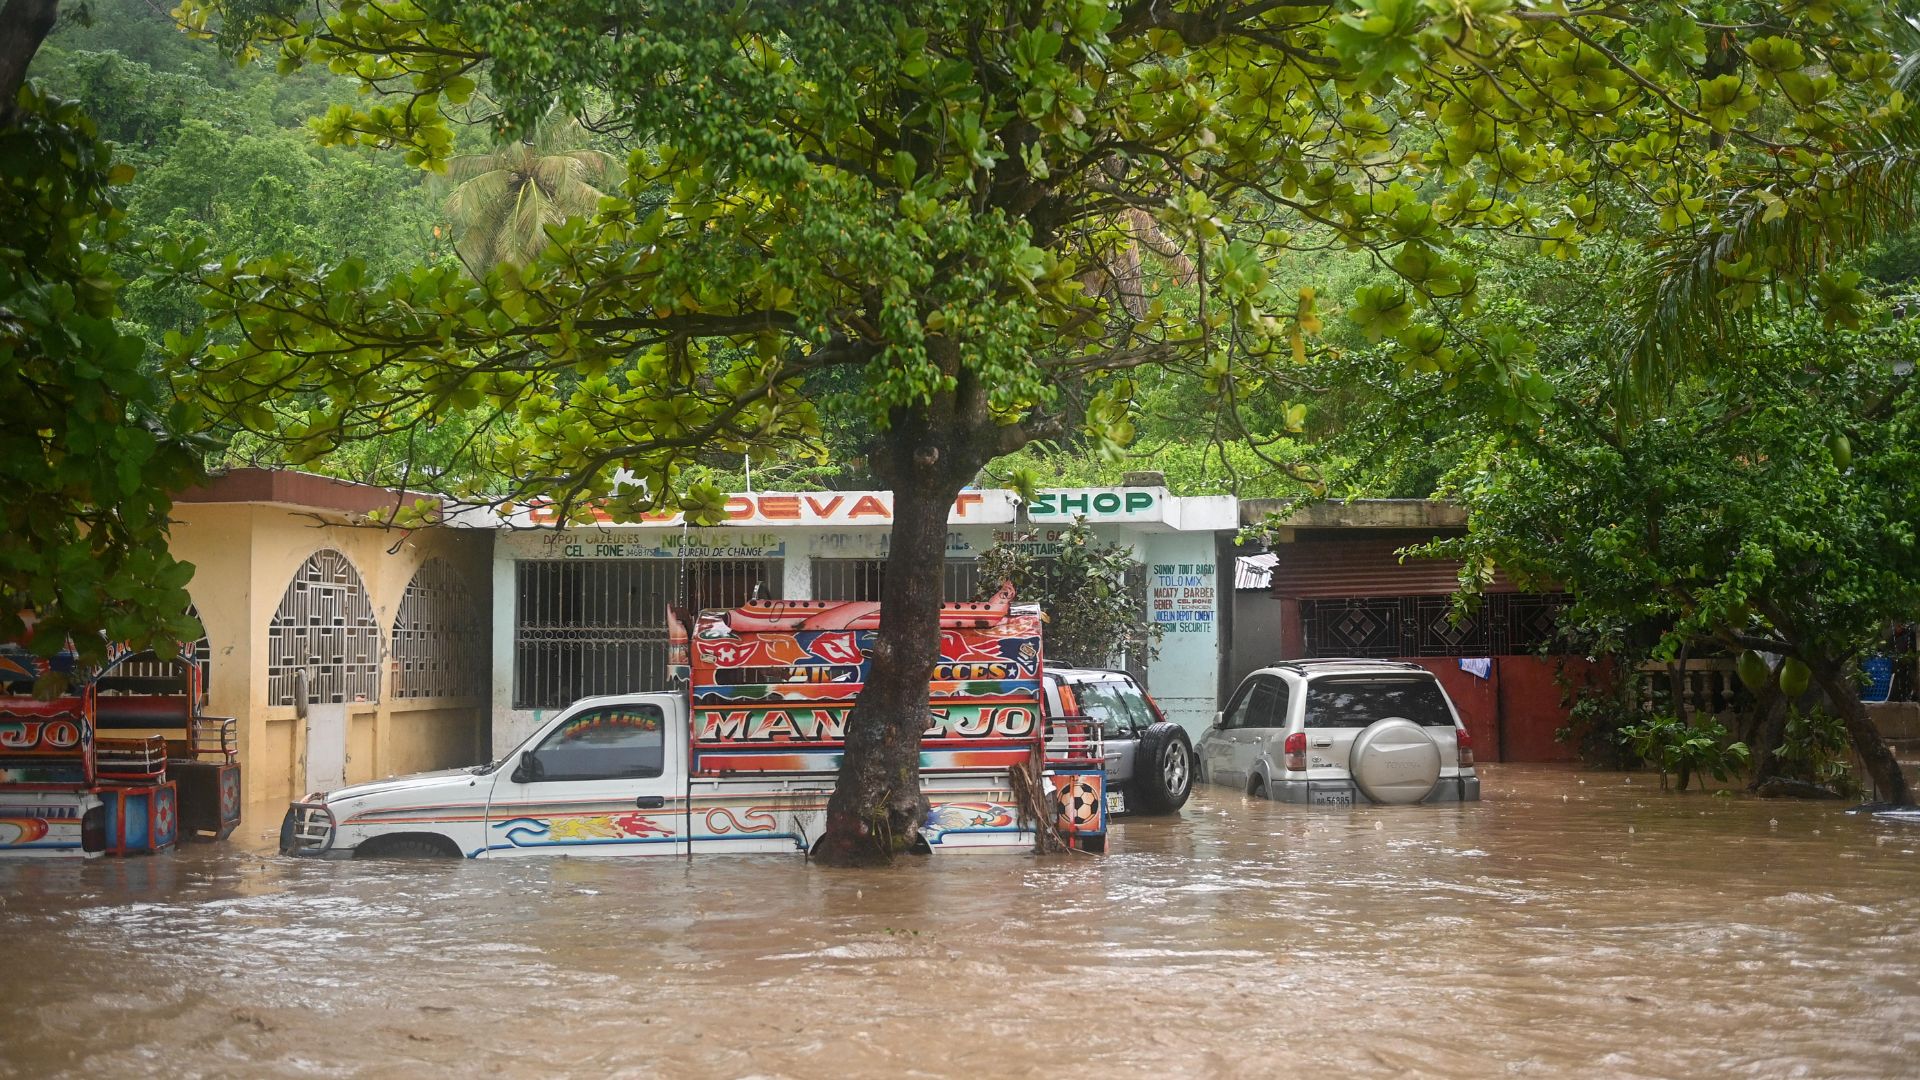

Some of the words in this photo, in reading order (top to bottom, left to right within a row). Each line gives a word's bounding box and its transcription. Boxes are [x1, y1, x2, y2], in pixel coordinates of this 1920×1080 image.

[717, 494, 983, 520] DEVAT
[1029, 492, 1153, 516] SHOP
[543, 534, 578, 545] DEPOT
[564, 544, 585, 557] CEL
[595, 544, 624, 557] FONE
[677, 547, 710, 557] BUREAU
[712, 547, 724, 557] DE
[727, 547, 762, 556] CHANGE
[1178, 564, 1194, 575] TOUT
[1183, 587, 1215, 598] BARBER
[1176, 610, 1193, 621] DEPOT
[1179, 622, 1211, 633] SECURITE
